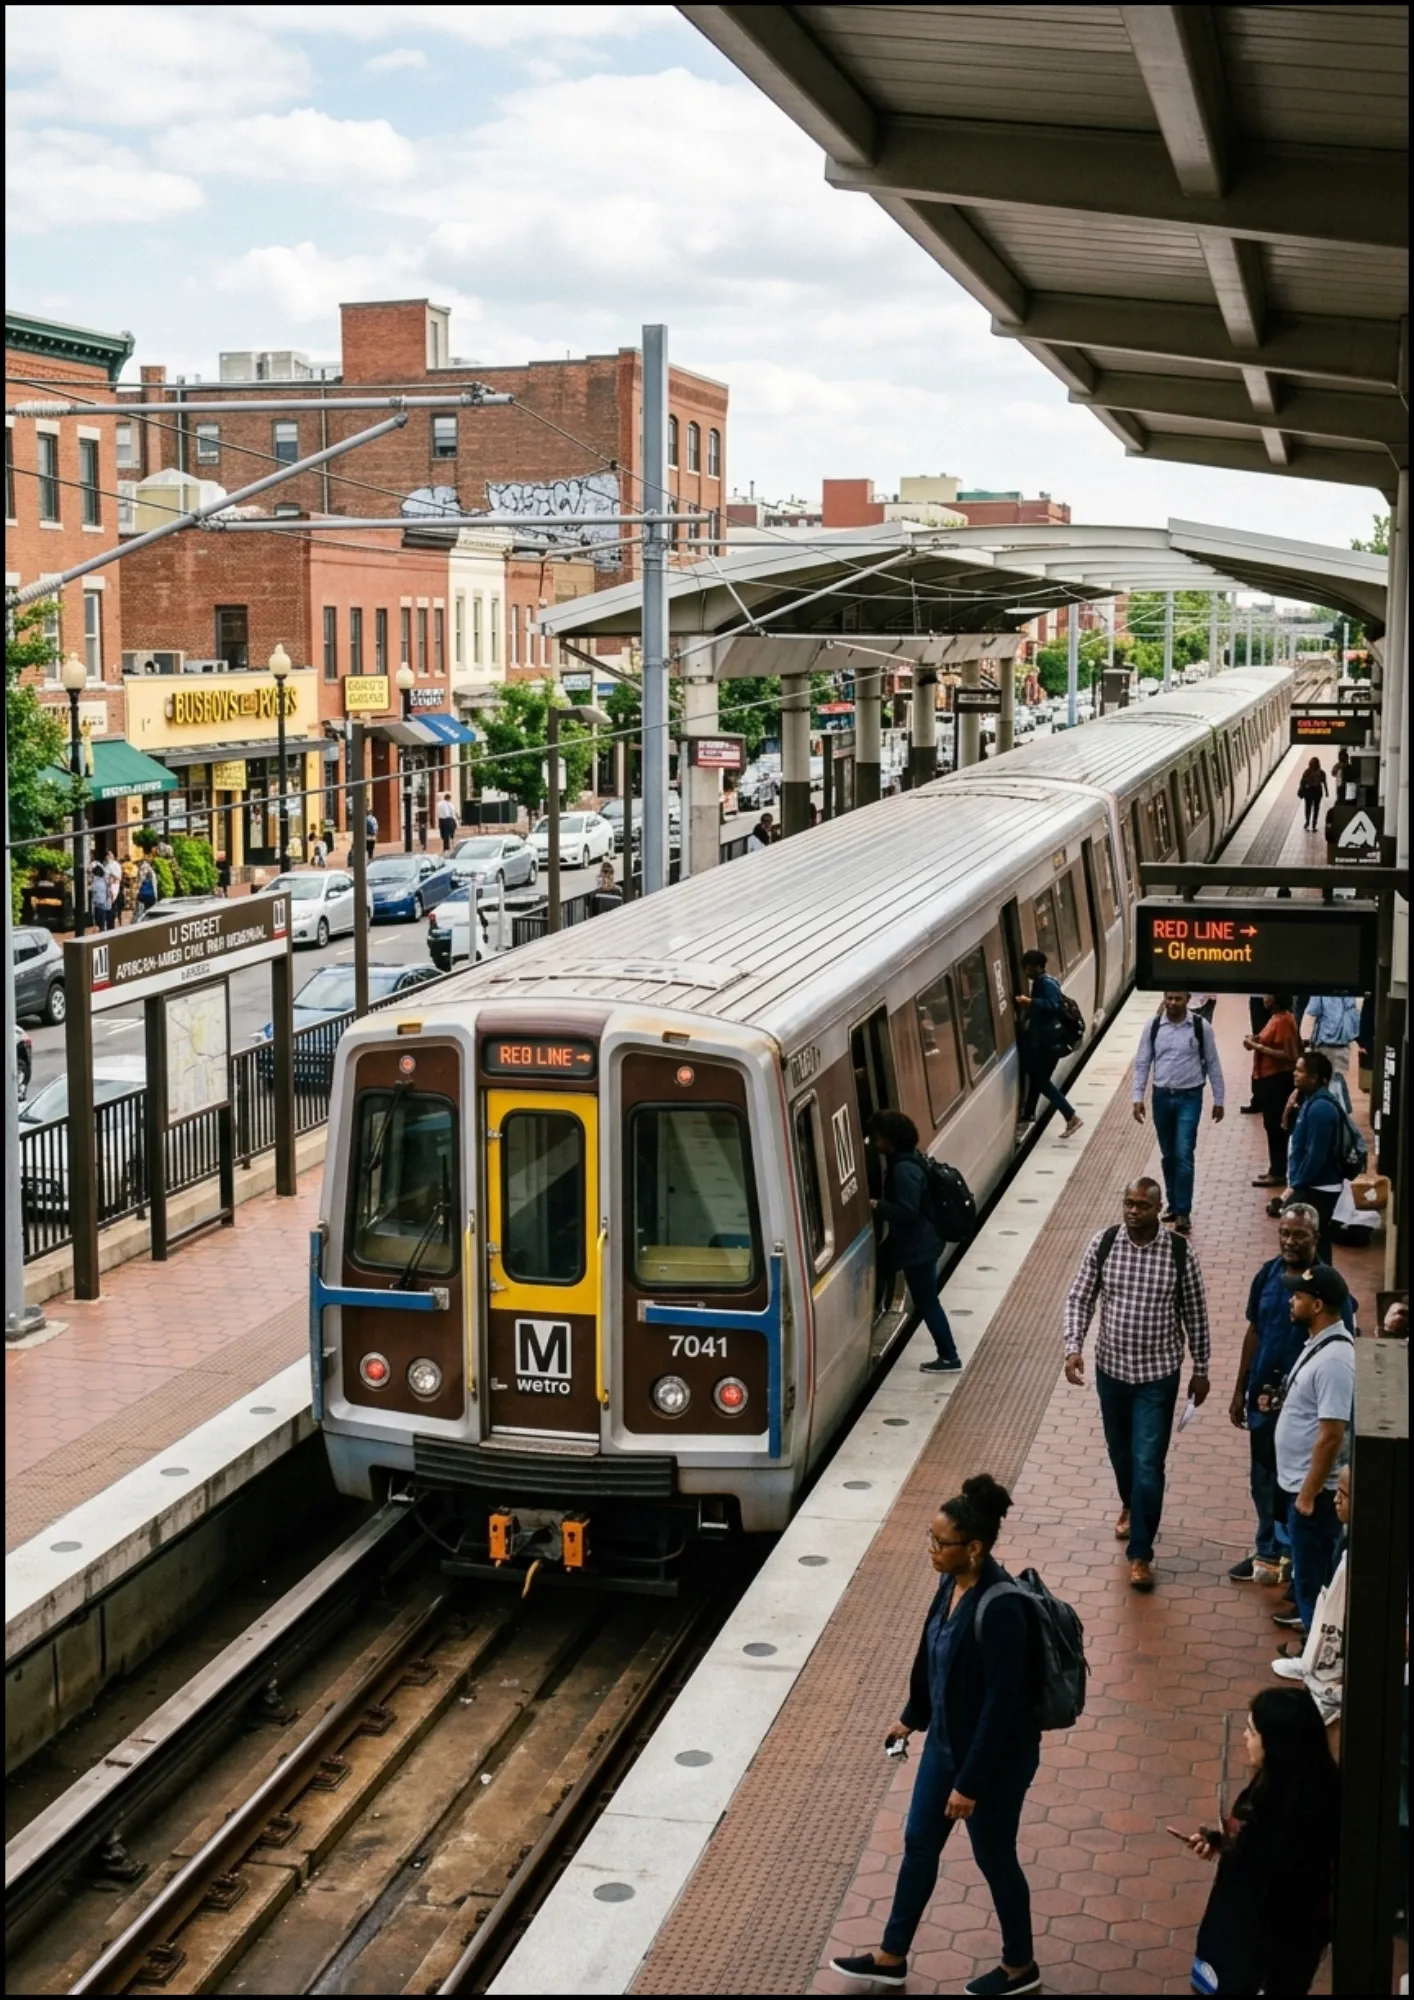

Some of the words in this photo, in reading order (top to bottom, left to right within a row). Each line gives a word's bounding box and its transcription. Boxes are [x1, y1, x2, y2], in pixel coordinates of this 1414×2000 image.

[1153, 920, 1188, 939] RED
[1194, 921, 1235, 940] LINE
[1168, 941, 1252, 962] Glenmont
[536, 1047, 573, 1067] LINE
[518, 1322, 568, 1375] M
[669, 1335, 728, 1358] 7041
